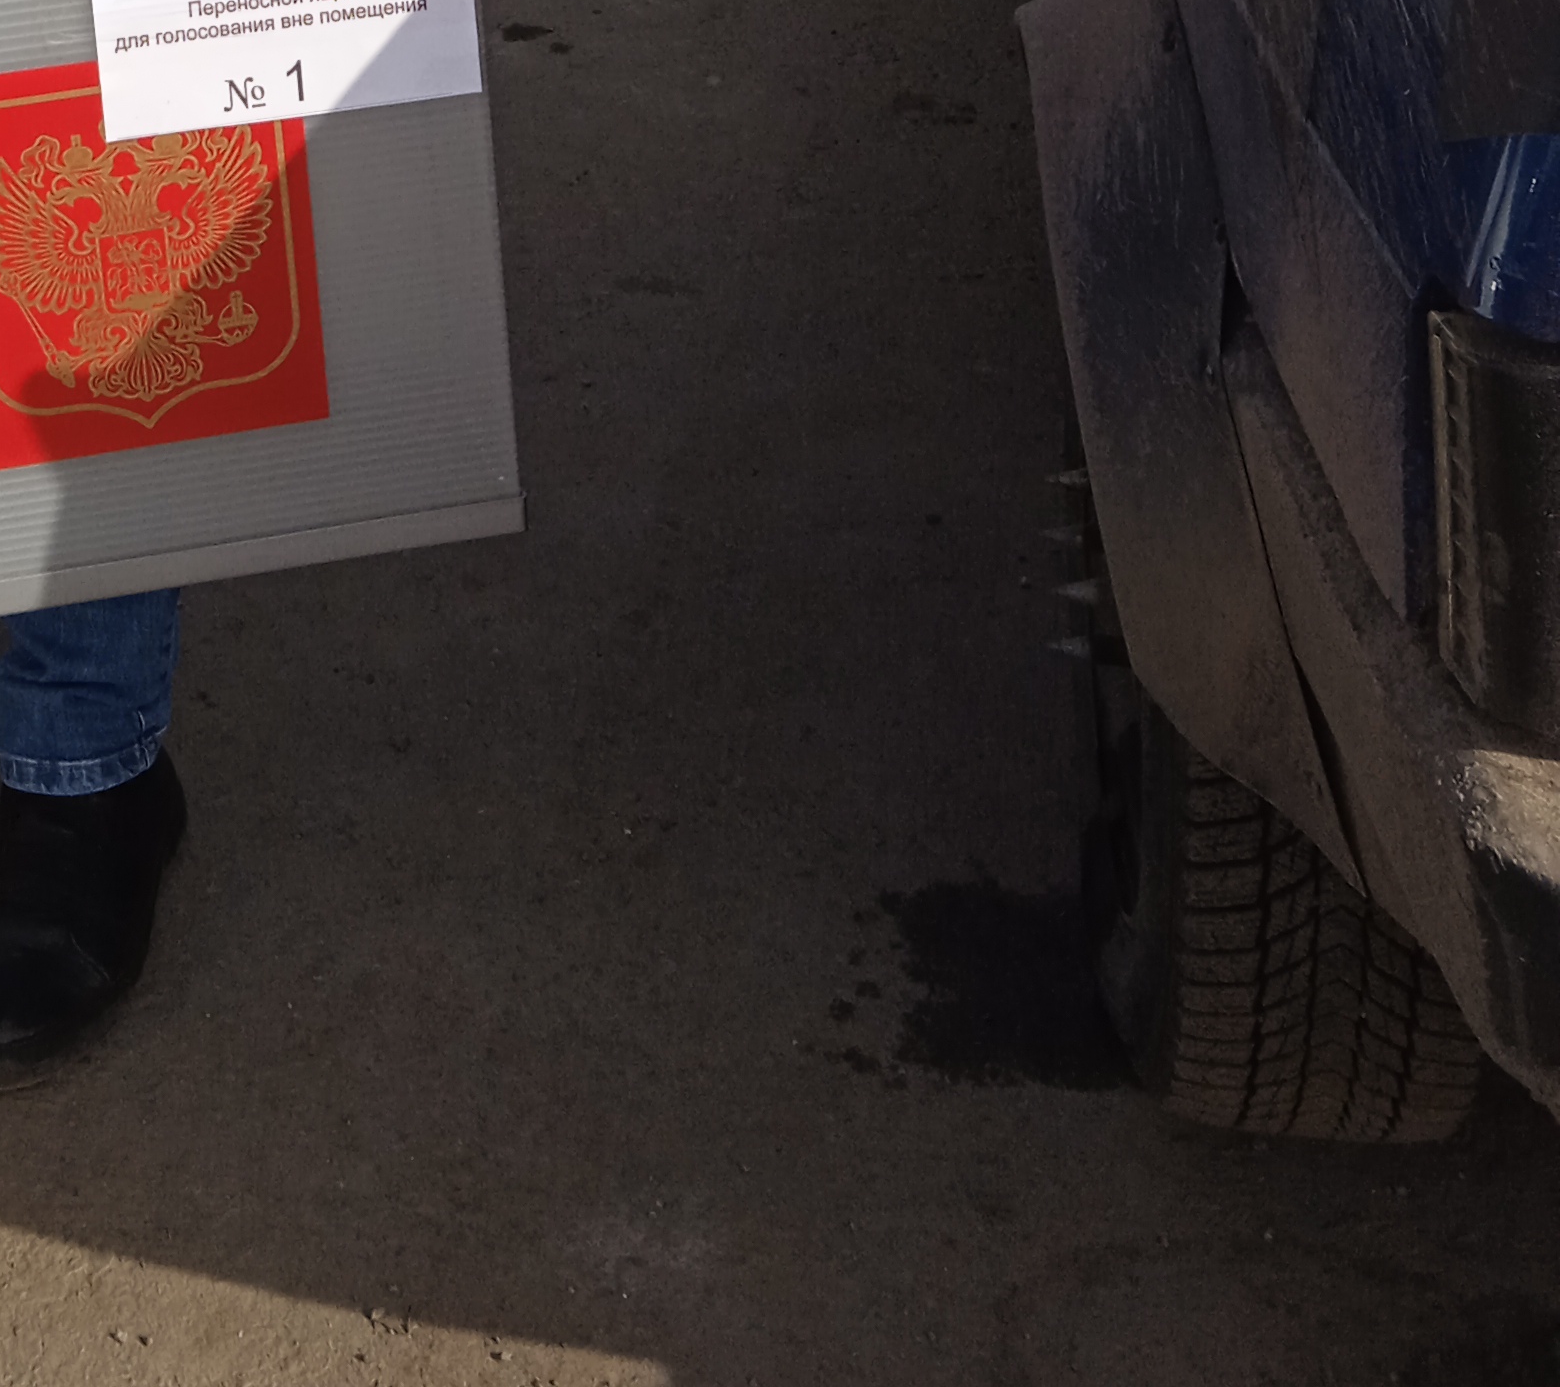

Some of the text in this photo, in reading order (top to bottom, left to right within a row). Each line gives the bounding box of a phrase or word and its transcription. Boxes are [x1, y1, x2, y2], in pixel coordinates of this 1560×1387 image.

[114, 32, 150, 53] для
[155, 16, 276, 47] голосования
[280, 12, 314, 30] вне
[223, 59, 306, 112] № 1
